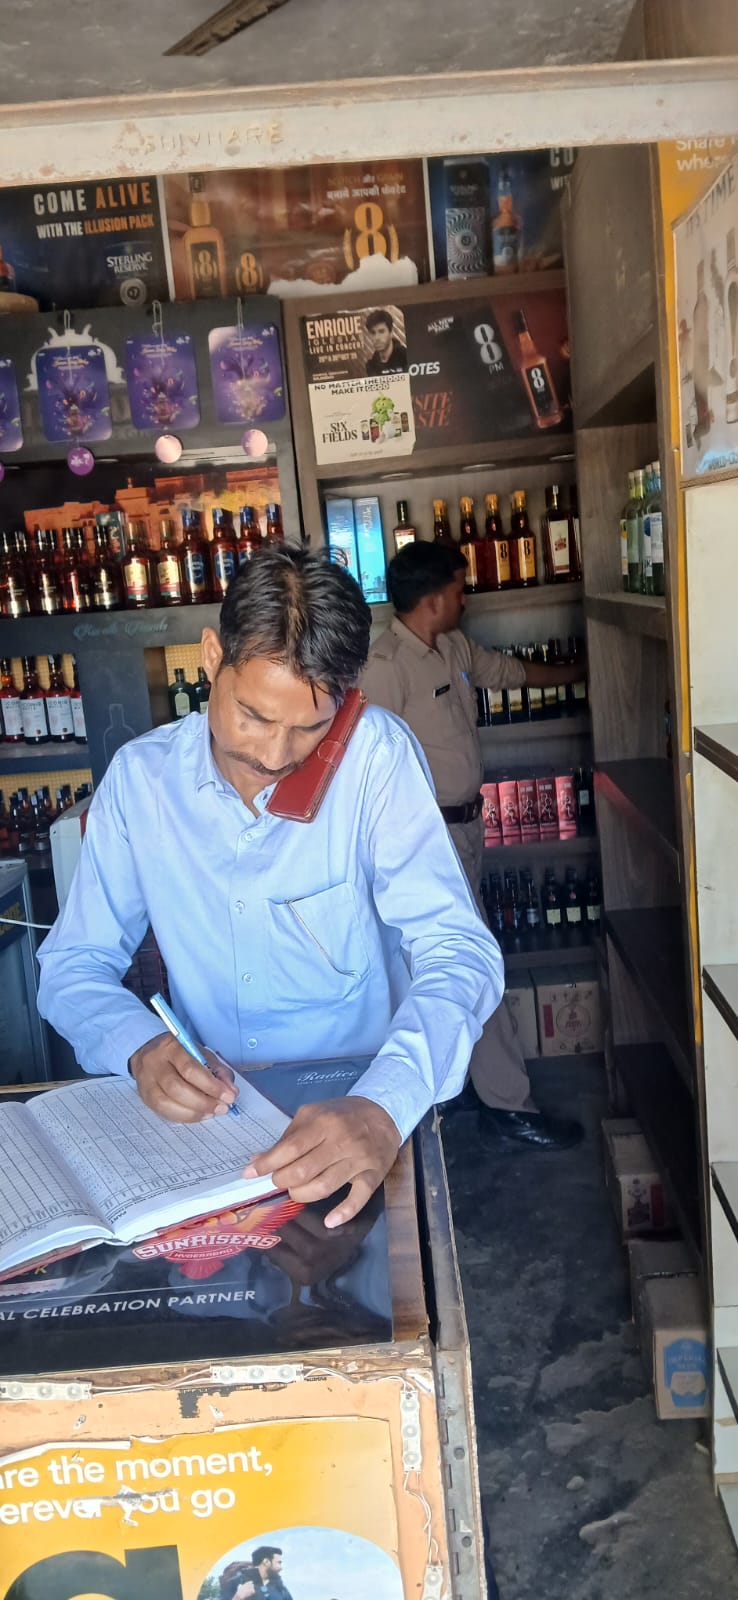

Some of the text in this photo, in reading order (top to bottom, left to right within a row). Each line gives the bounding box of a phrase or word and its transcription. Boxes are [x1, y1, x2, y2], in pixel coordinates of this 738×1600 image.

[33, 181, 152, 216] COME ALIVE
[36, 213, 154, 239] WITH THE ILLUSION PACK
[106, 251, 153, 268] STERLING
[306, 315, 363, 340] ENRIQUE
[309, 346, 324, 355] LIVE
[326, 345, 334, 353] IN
[473, 323, 502, 364] 8
[331, 387, 356, 395] MAKE
[322, 429, 358, 444] FIELDS
[330, 420, 348, 432] SIX
[23, 1298, 160, 1320] CELEBRATION
[168, 1290, 256, 1307] PARTNER
[48, 1456, 105, 1485] the
[116, 1445, 273, 1482] moment,
[190, 1488, 236, 1518] go
